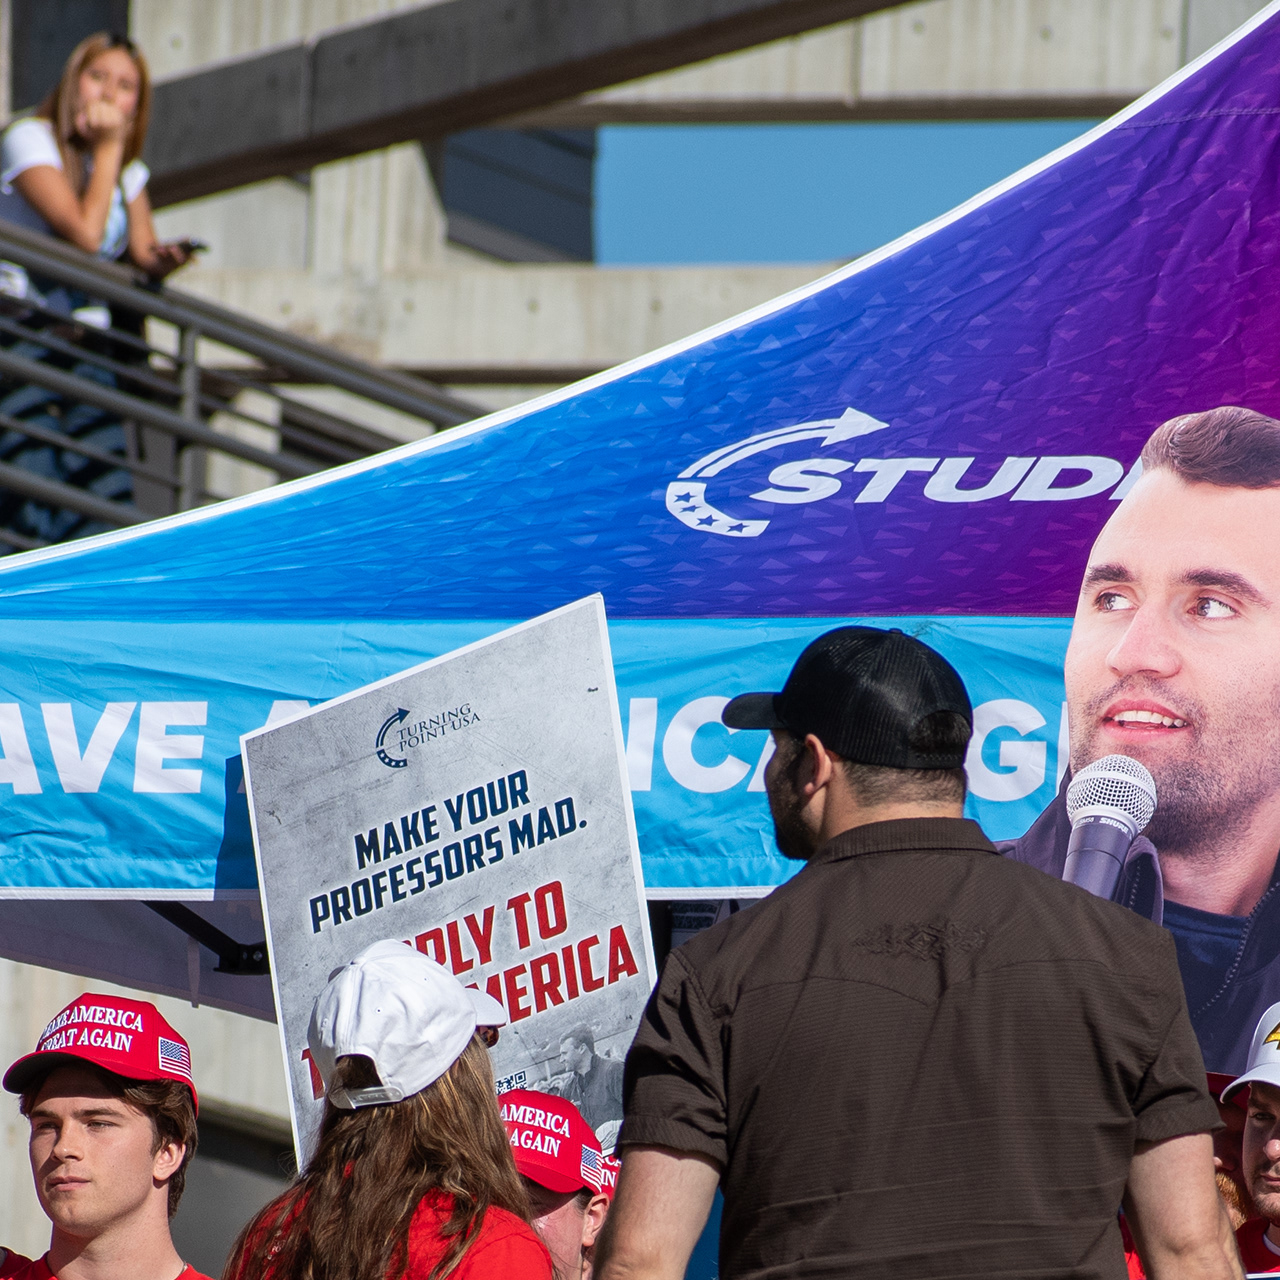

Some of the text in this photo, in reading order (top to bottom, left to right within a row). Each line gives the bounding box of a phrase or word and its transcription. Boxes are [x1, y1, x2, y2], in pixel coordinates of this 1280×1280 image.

[396, 703, 472, 740] TURNING
[399, 711, 482, 752] POINT USA
[354, 769, 531, 869] MAKE YOUR
[310, 797, 587, 934] PROFESSORS MAD.
[506, 880, 568, 950] TO
[70, 1005, 143, 1032] AMERICA
[77, 1028, 133, 1052] AGAIN
[500, 1103, 570, 1138] AMERICA
[510, 1130, 561, 1157] AGAIN
